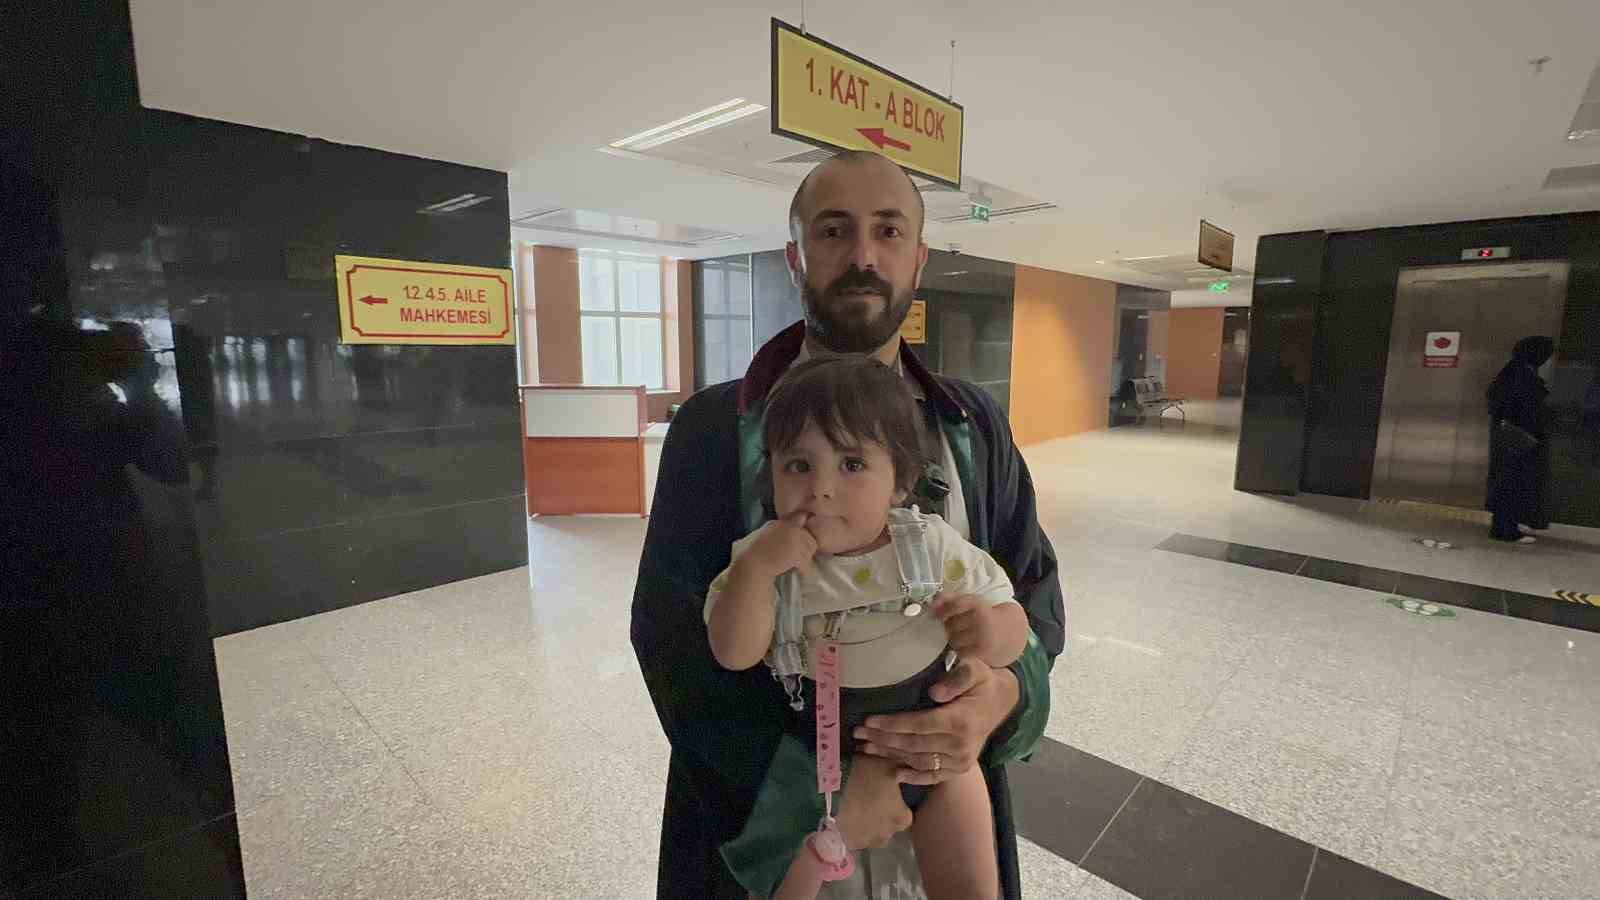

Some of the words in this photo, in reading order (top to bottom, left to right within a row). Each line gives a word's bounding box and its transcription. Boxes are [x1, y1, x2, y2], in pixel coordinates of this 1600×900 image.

[806, 57, 822, 96] 1.
[830, 66, 869, 112] KAT
[885, 92, 897, 124] A
[903, 97, 946, 143] BLOK
[400, 307, 491, 324] MAHKEMESİ
